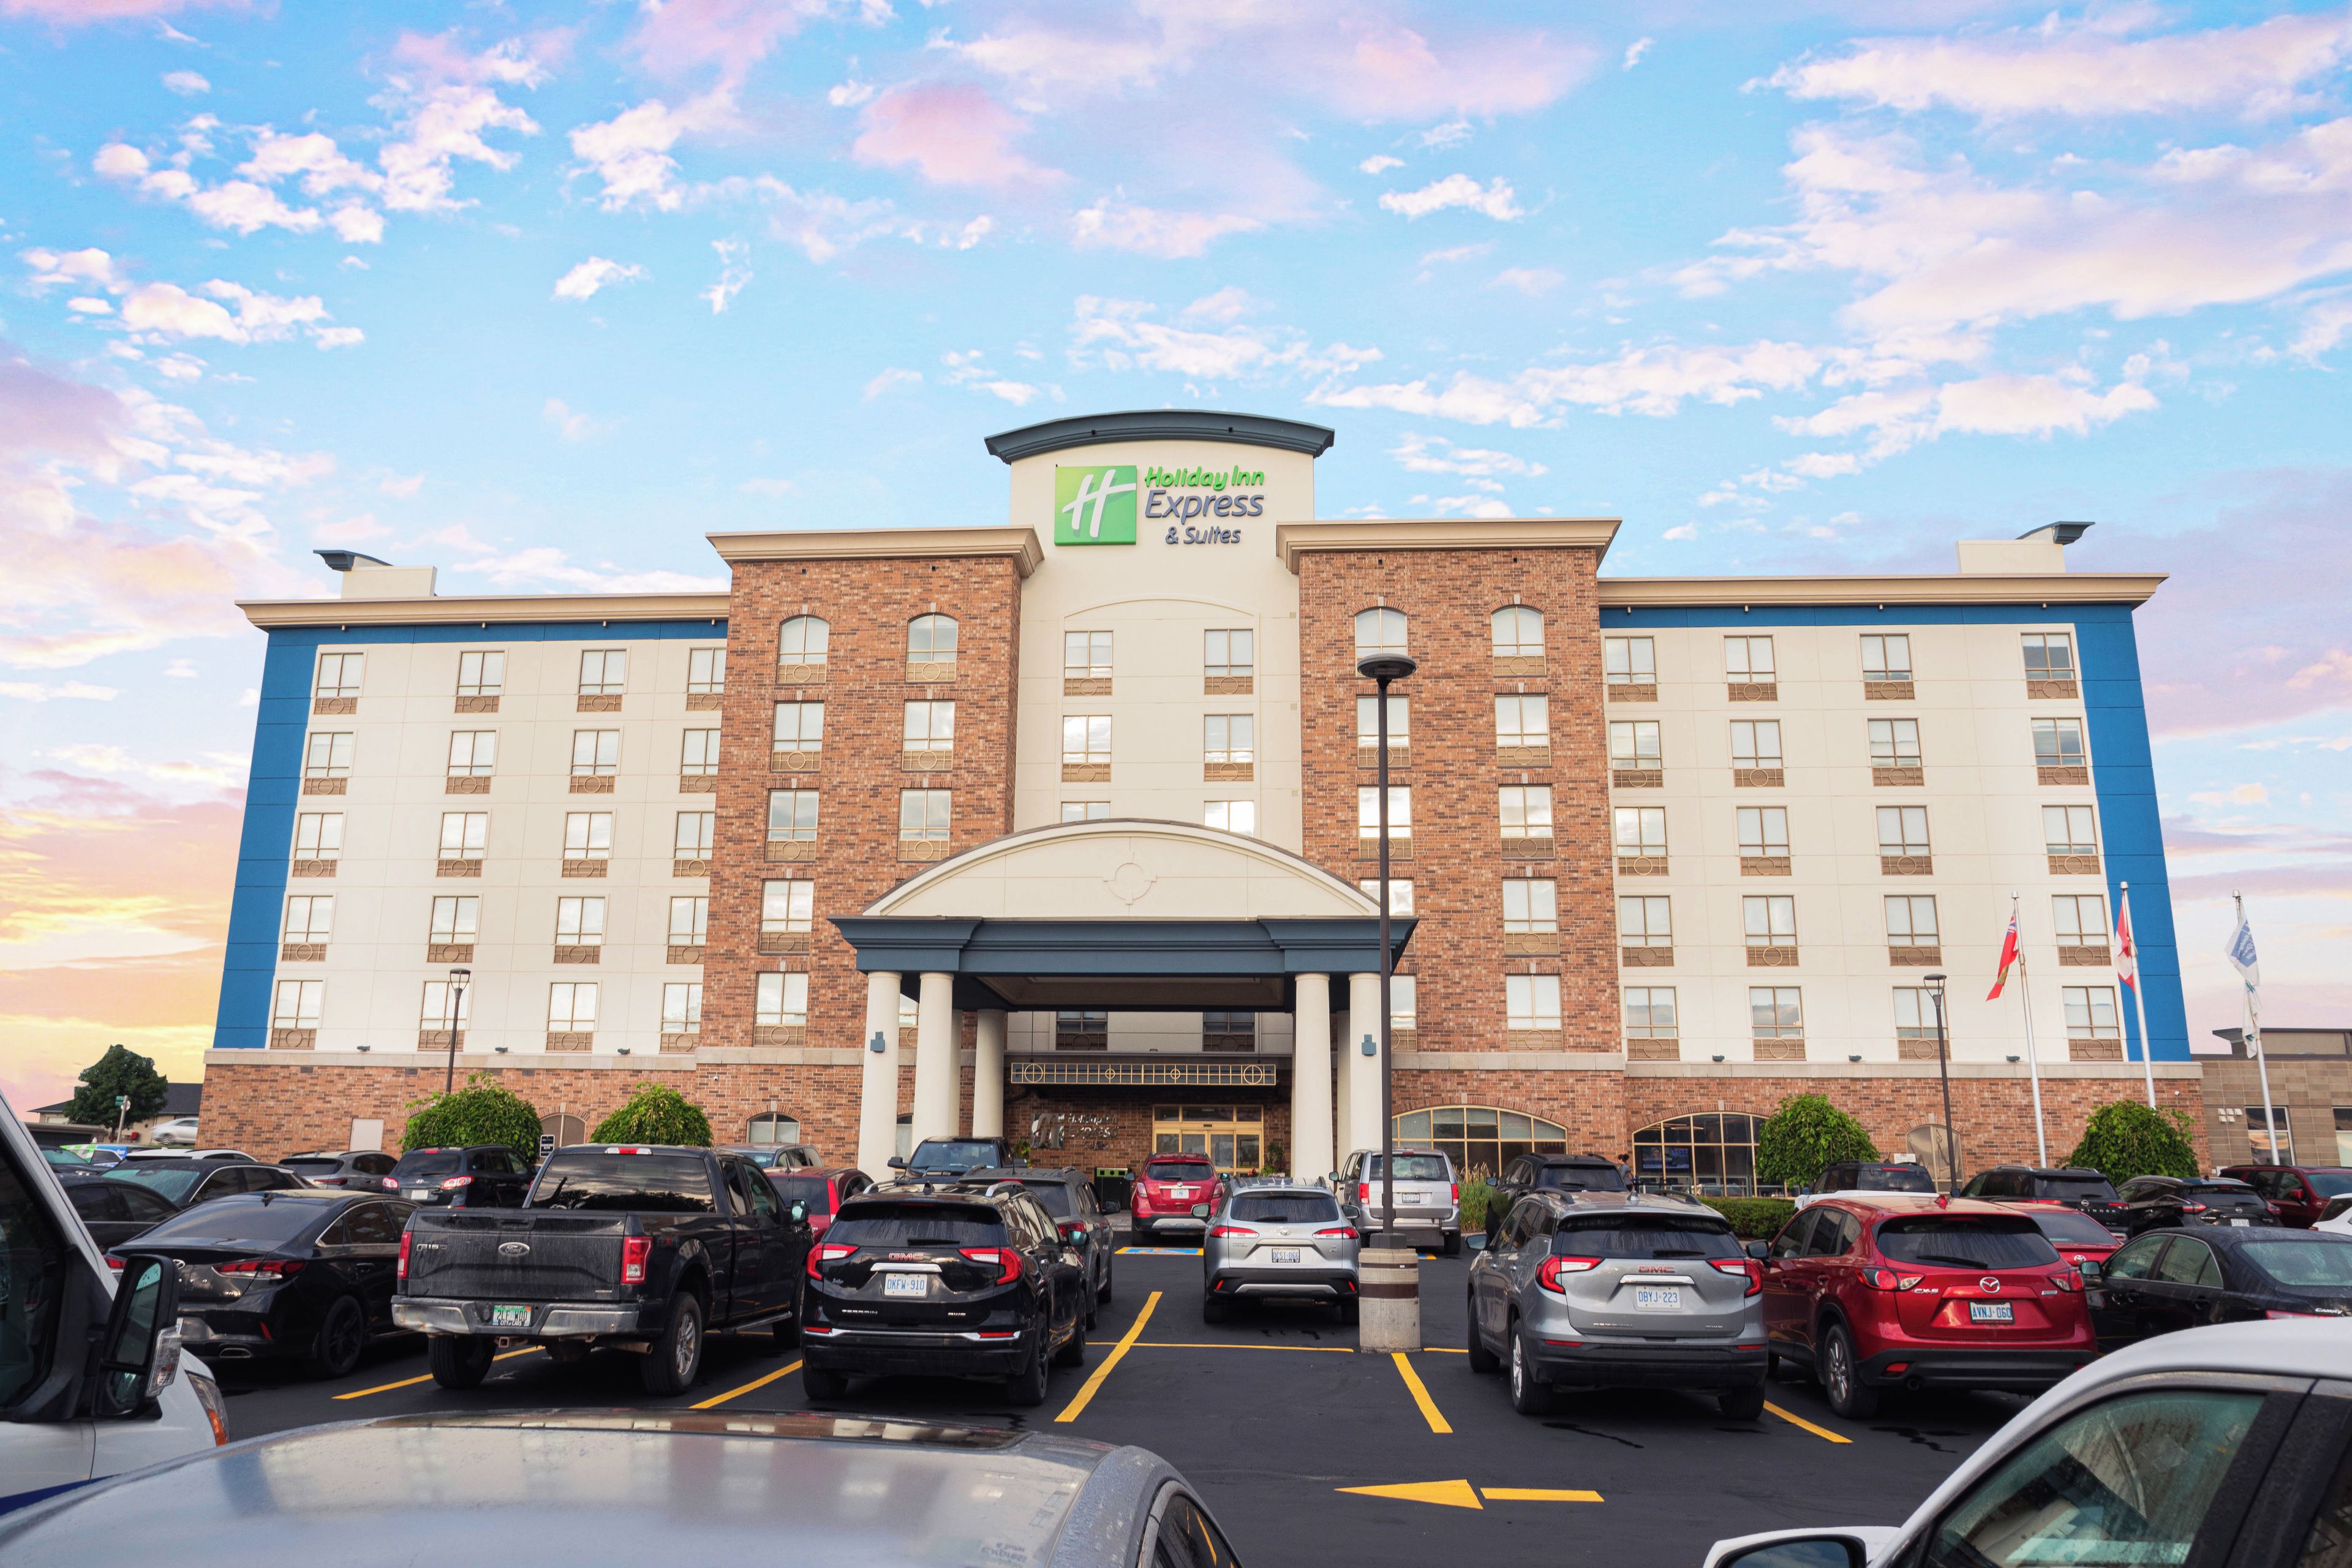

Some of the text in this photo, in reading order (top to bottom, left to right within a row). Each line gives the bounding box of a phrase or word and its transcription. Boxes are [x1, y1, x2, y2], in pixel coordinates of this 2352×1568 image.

[1144, 465, 1265, 491] Holiday Inn
[1145, 489, 1264, 525] Express
[1165, 526, 1241, 545] & Suites
[1638, 1265, 1675, 1273] GMC
